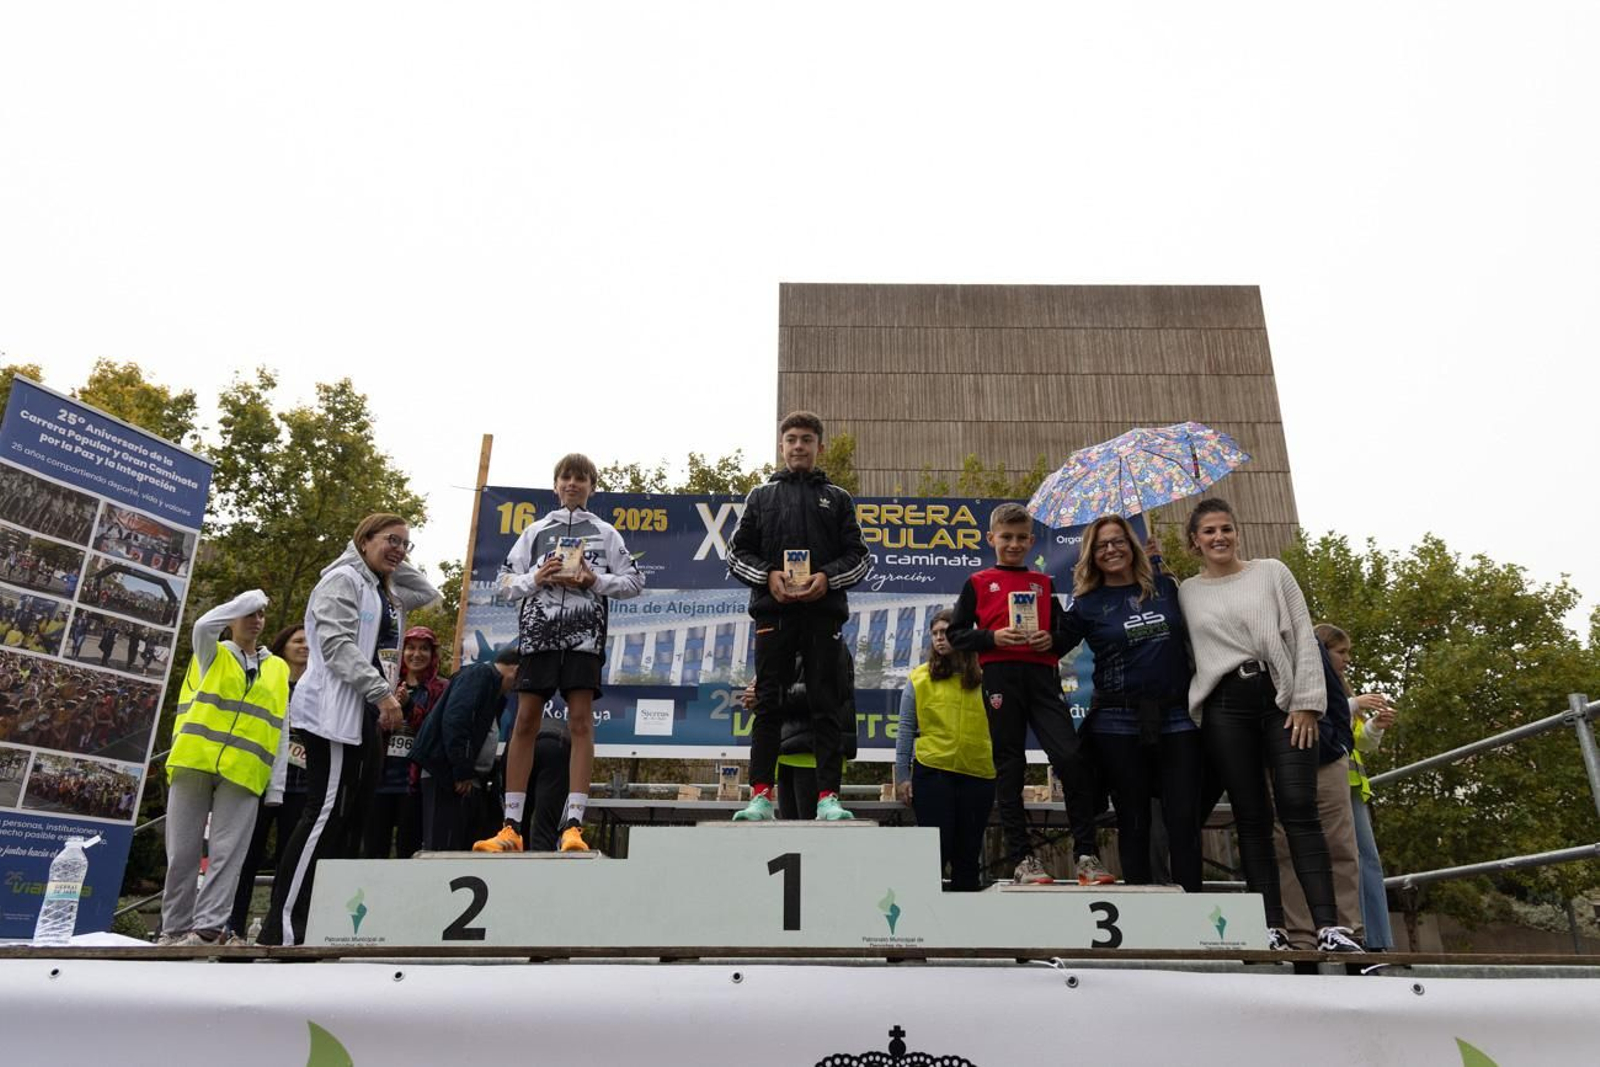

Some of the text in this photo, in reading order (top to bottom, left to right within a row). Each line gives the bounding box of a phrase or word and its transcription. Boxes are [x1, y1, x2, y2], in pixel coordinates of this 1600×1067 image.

[20, 410, 198, 490] Carrera Popular y Gran Caminata
[85, 423, 149, 457] Aniversario
[149, 451, 162, 462] de
[163, 456, 174, 467] la
[39, 432, 177, 493] por la Paz y la Integración
[11, 441, 23, 452] 25
[24, 447, 45, 461] años
[46, 458, 107, 485] compartiendo
[142, 492, 158, 504] vida
[164, 502, 192, 517] valores
[497, 501, 668, 535] 16 2025
[855, 503, 978, 526] RRERA
[861, 527, 982, 550] PULAR
[787, 550, 808, 562] XXV
[885, 553, 982, 567] caminata
[863, 566, 936, 592] tegración
[609, 600, 638, 613] lina
[642, 601, 661, 614] de
[665, 601, 746, 617] Alejandría
[1013, 593, 1036, 605] XXV
[1123, 610, 1166, 630] 25
[24, 830, 56, 840] posible
[46, 823, 98, 835] instituciones
[767, 852, 802, 931] 1
[441, 875, 490, 941] 2
[1088, 901, 1123, 949] 3
